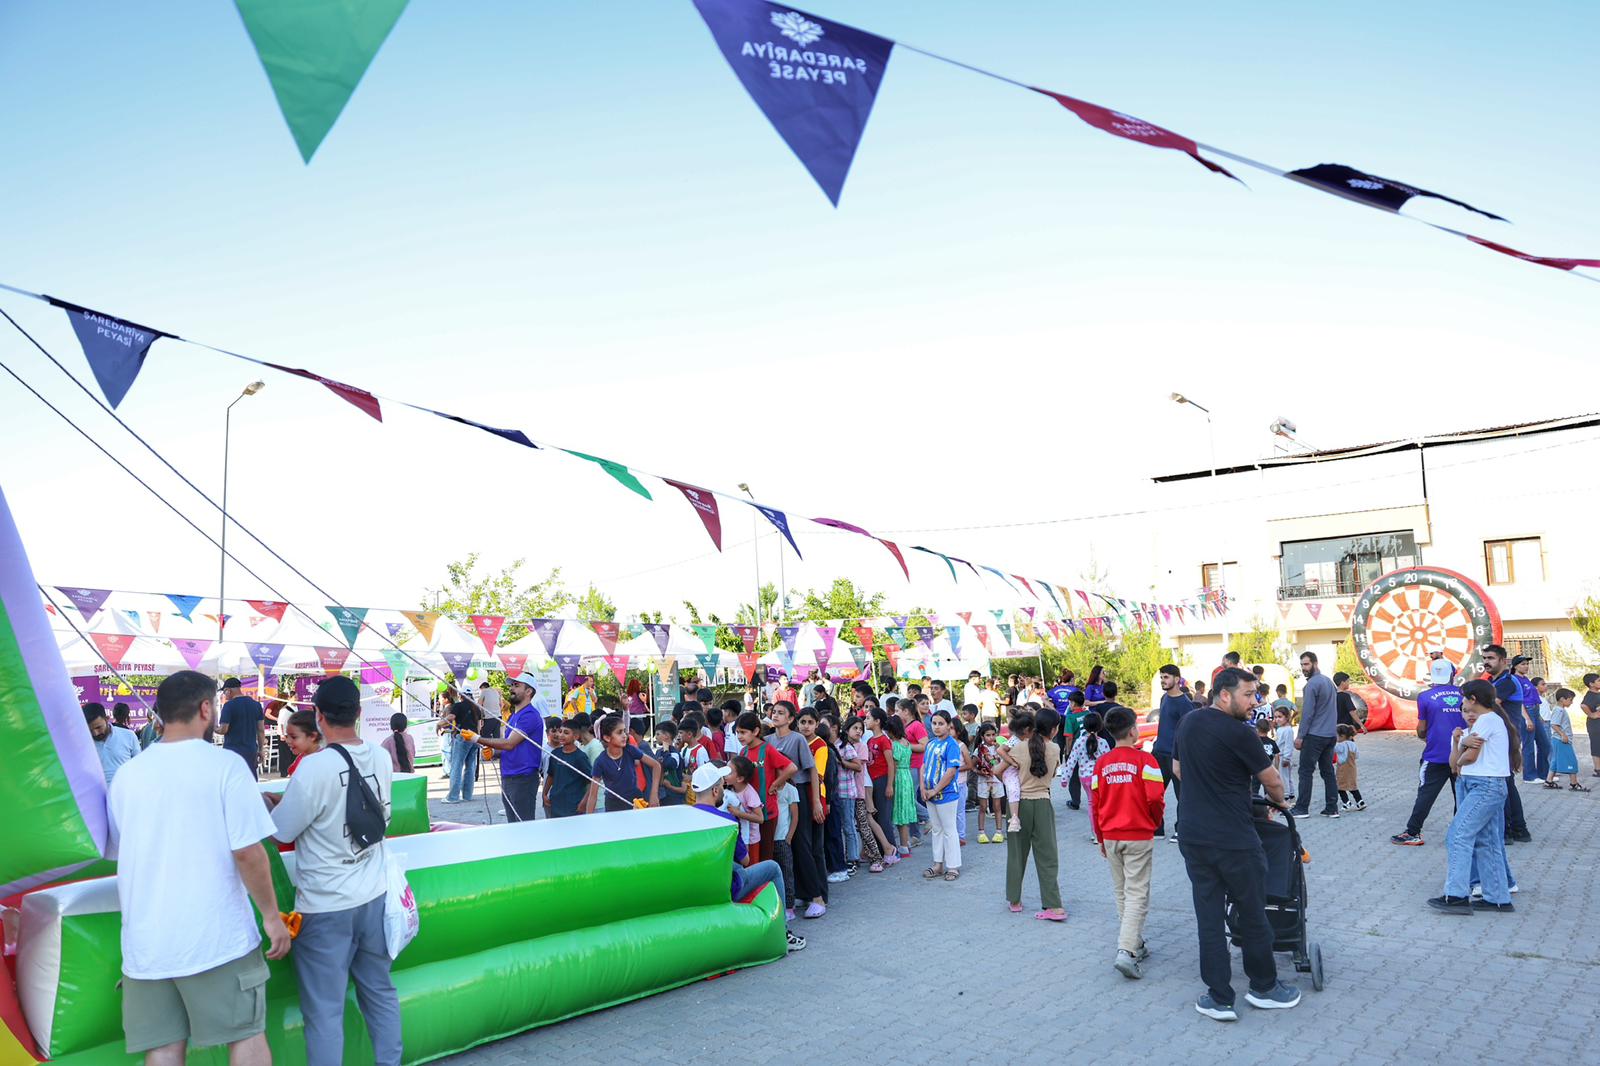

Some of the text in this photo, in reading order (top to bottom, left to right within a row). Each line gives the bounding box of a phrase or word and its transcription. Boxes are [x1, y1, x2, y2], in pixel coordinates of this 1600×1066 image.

[1388, 577, 1396, 587] 5
[1404, 573, 1418, 583] 20
[1370, 584, 1382, 595] 12
[1362, 599, 1370, 609] 9
[1470, 606, 1486, 618] 13
[1352, 614, 1364, 625] 14
[1475, 625, 1485, 636] 6
[1364, 665, 1378, 677] 16
[1469, 662, 1485, 674] 15
[1399, 687, 1411, 698] 19
